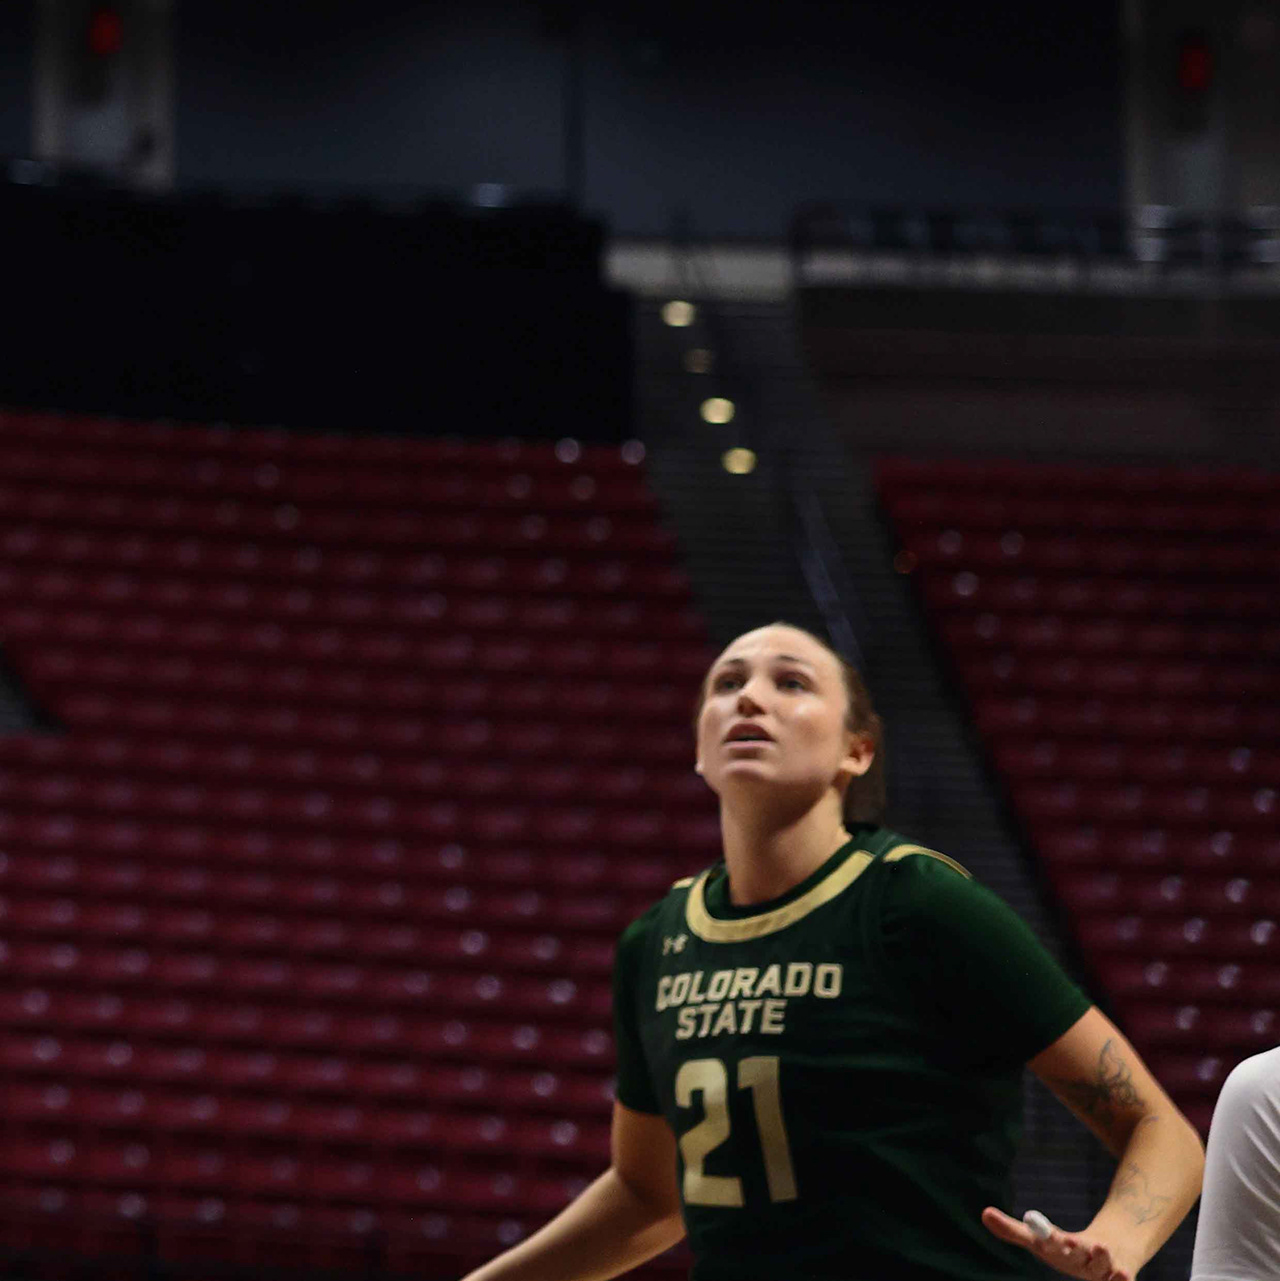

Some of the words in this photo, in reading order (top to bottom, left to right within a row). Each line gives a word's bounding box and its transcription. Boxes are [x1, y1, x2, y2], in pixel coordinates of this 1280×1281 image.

[655, 962, 844, 1012] COLORADO
[674, 998, 789, 1040] STATE
[674, 1055, 798, 1208] 21
